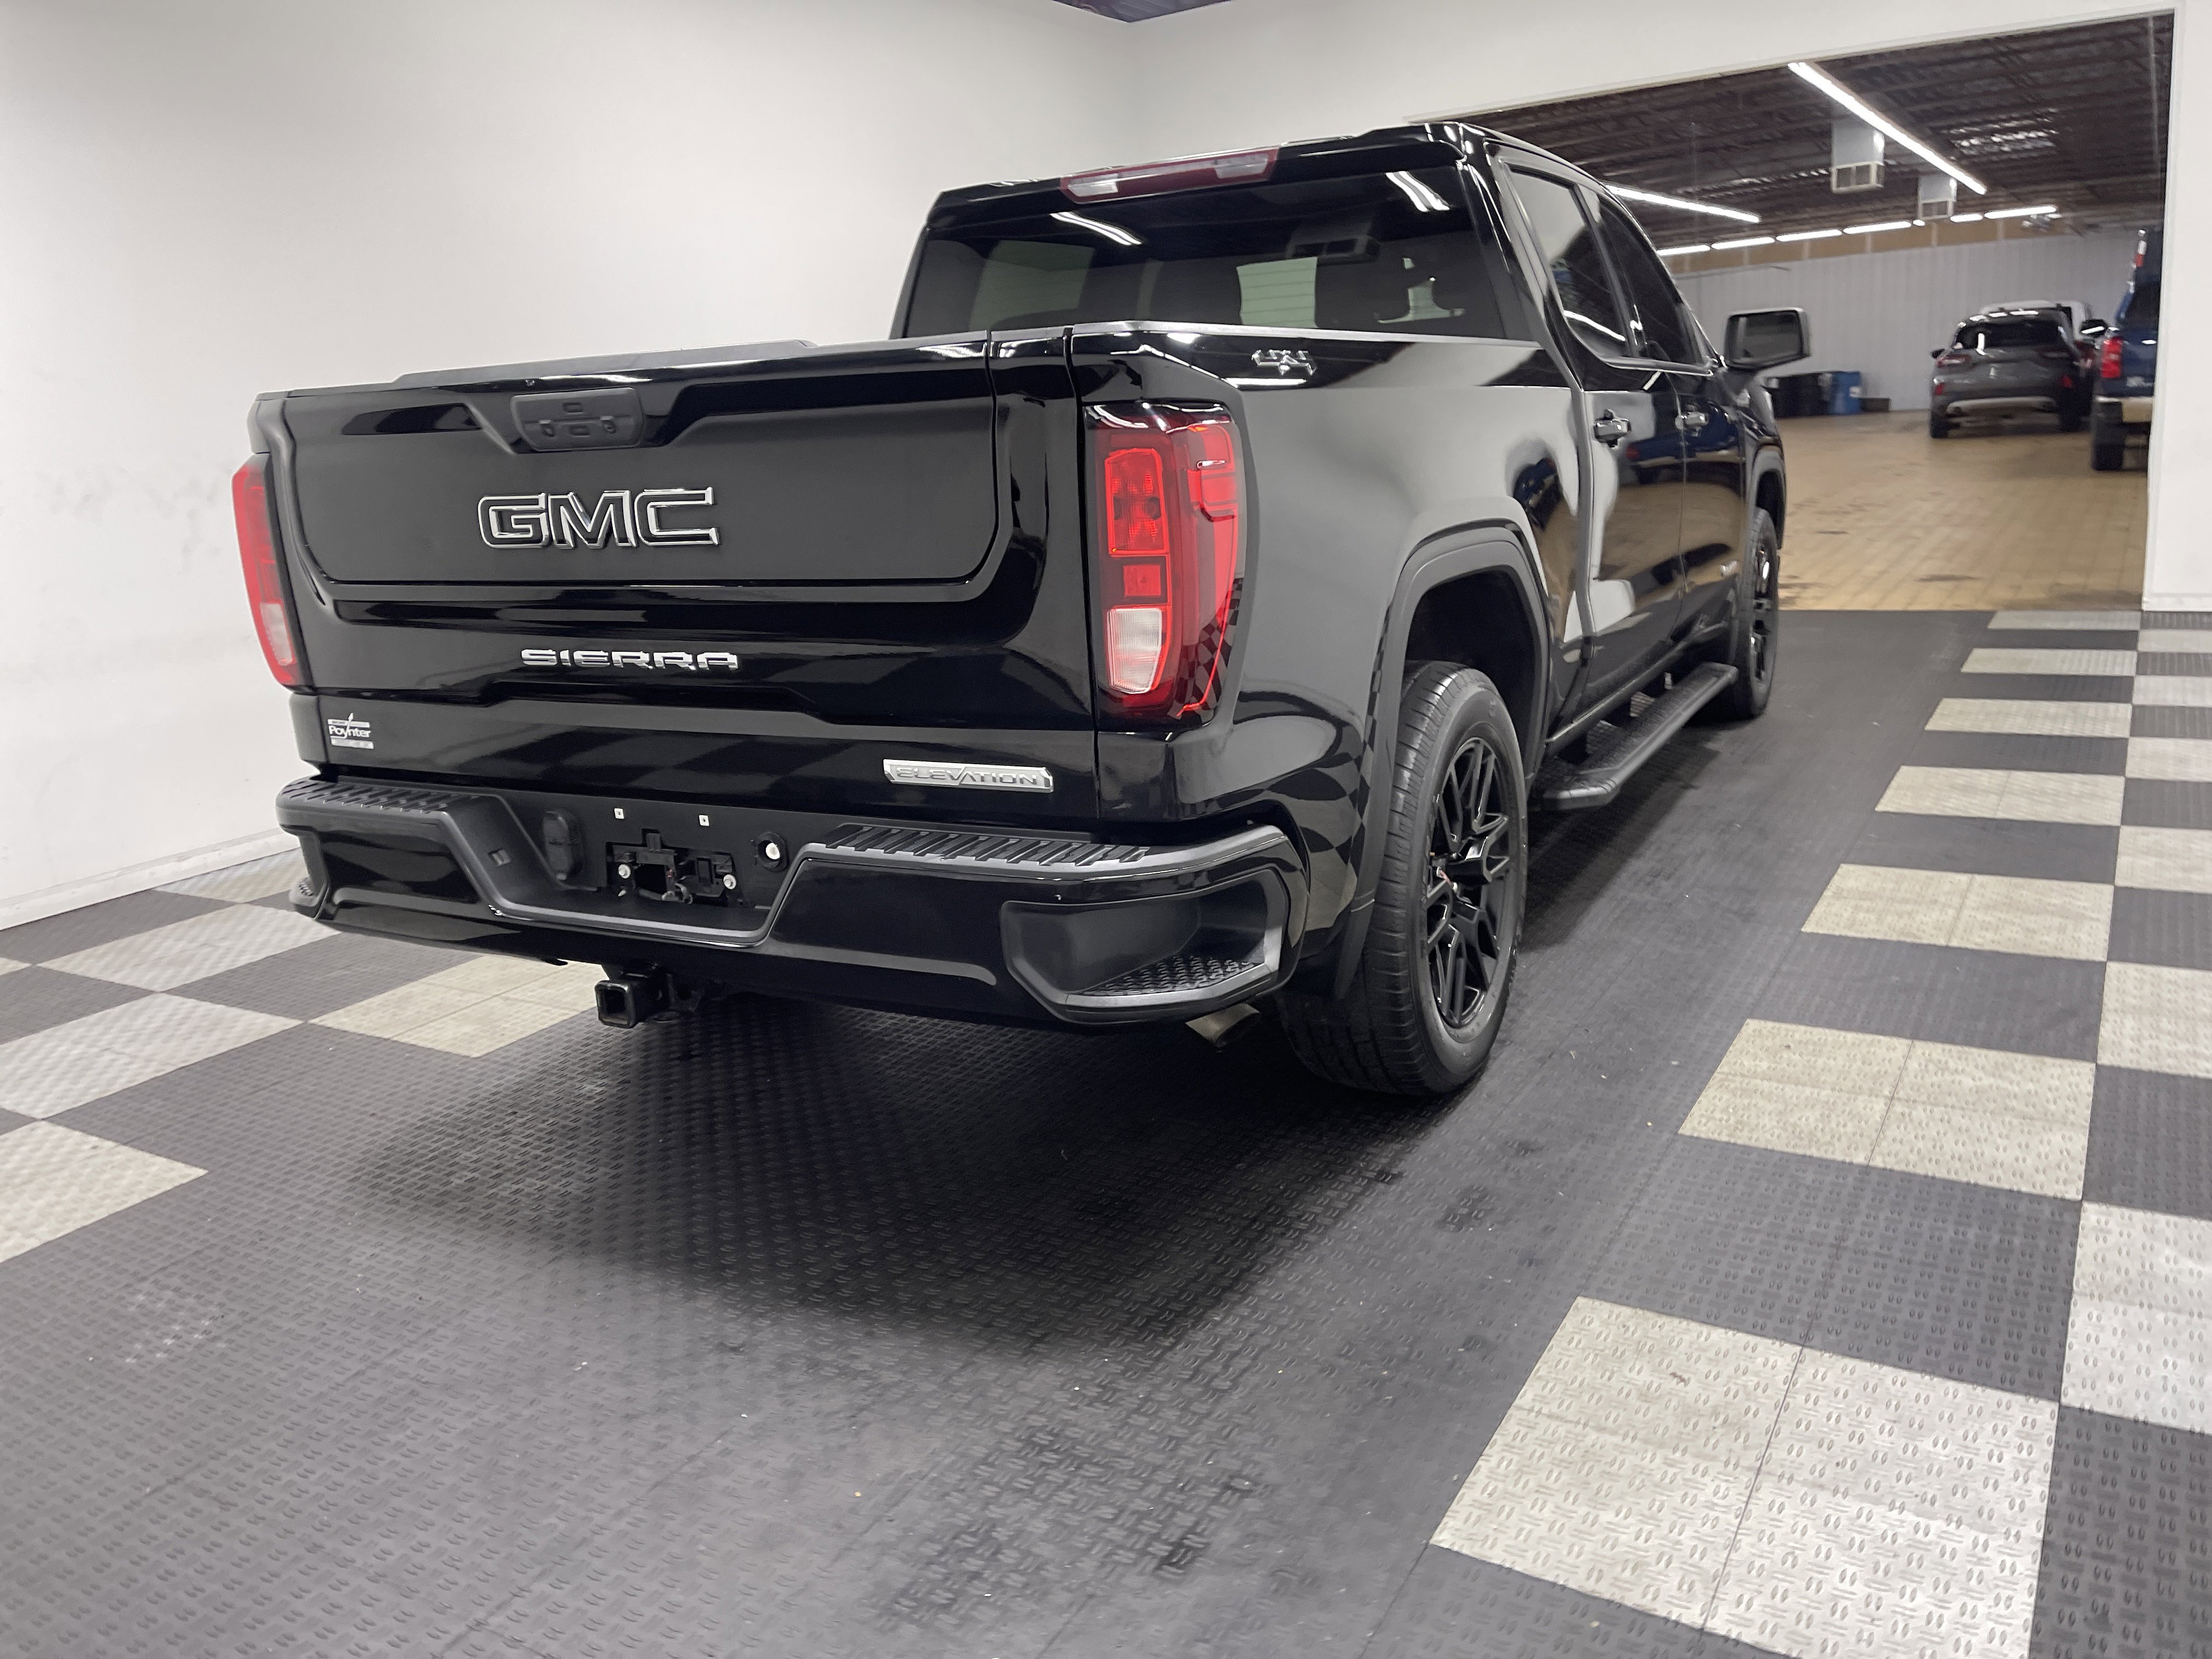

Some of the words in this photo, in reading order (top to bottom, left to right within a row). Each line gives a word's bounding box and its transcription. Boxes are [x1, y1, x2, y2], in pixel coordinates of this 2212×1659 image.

[478, 487, 719, 549] GMC
[521, 649, 738, 670] SIERRA
[328, 725, 371, 738] Poynter
[896, 766, 1037, 786] ELEVATION
